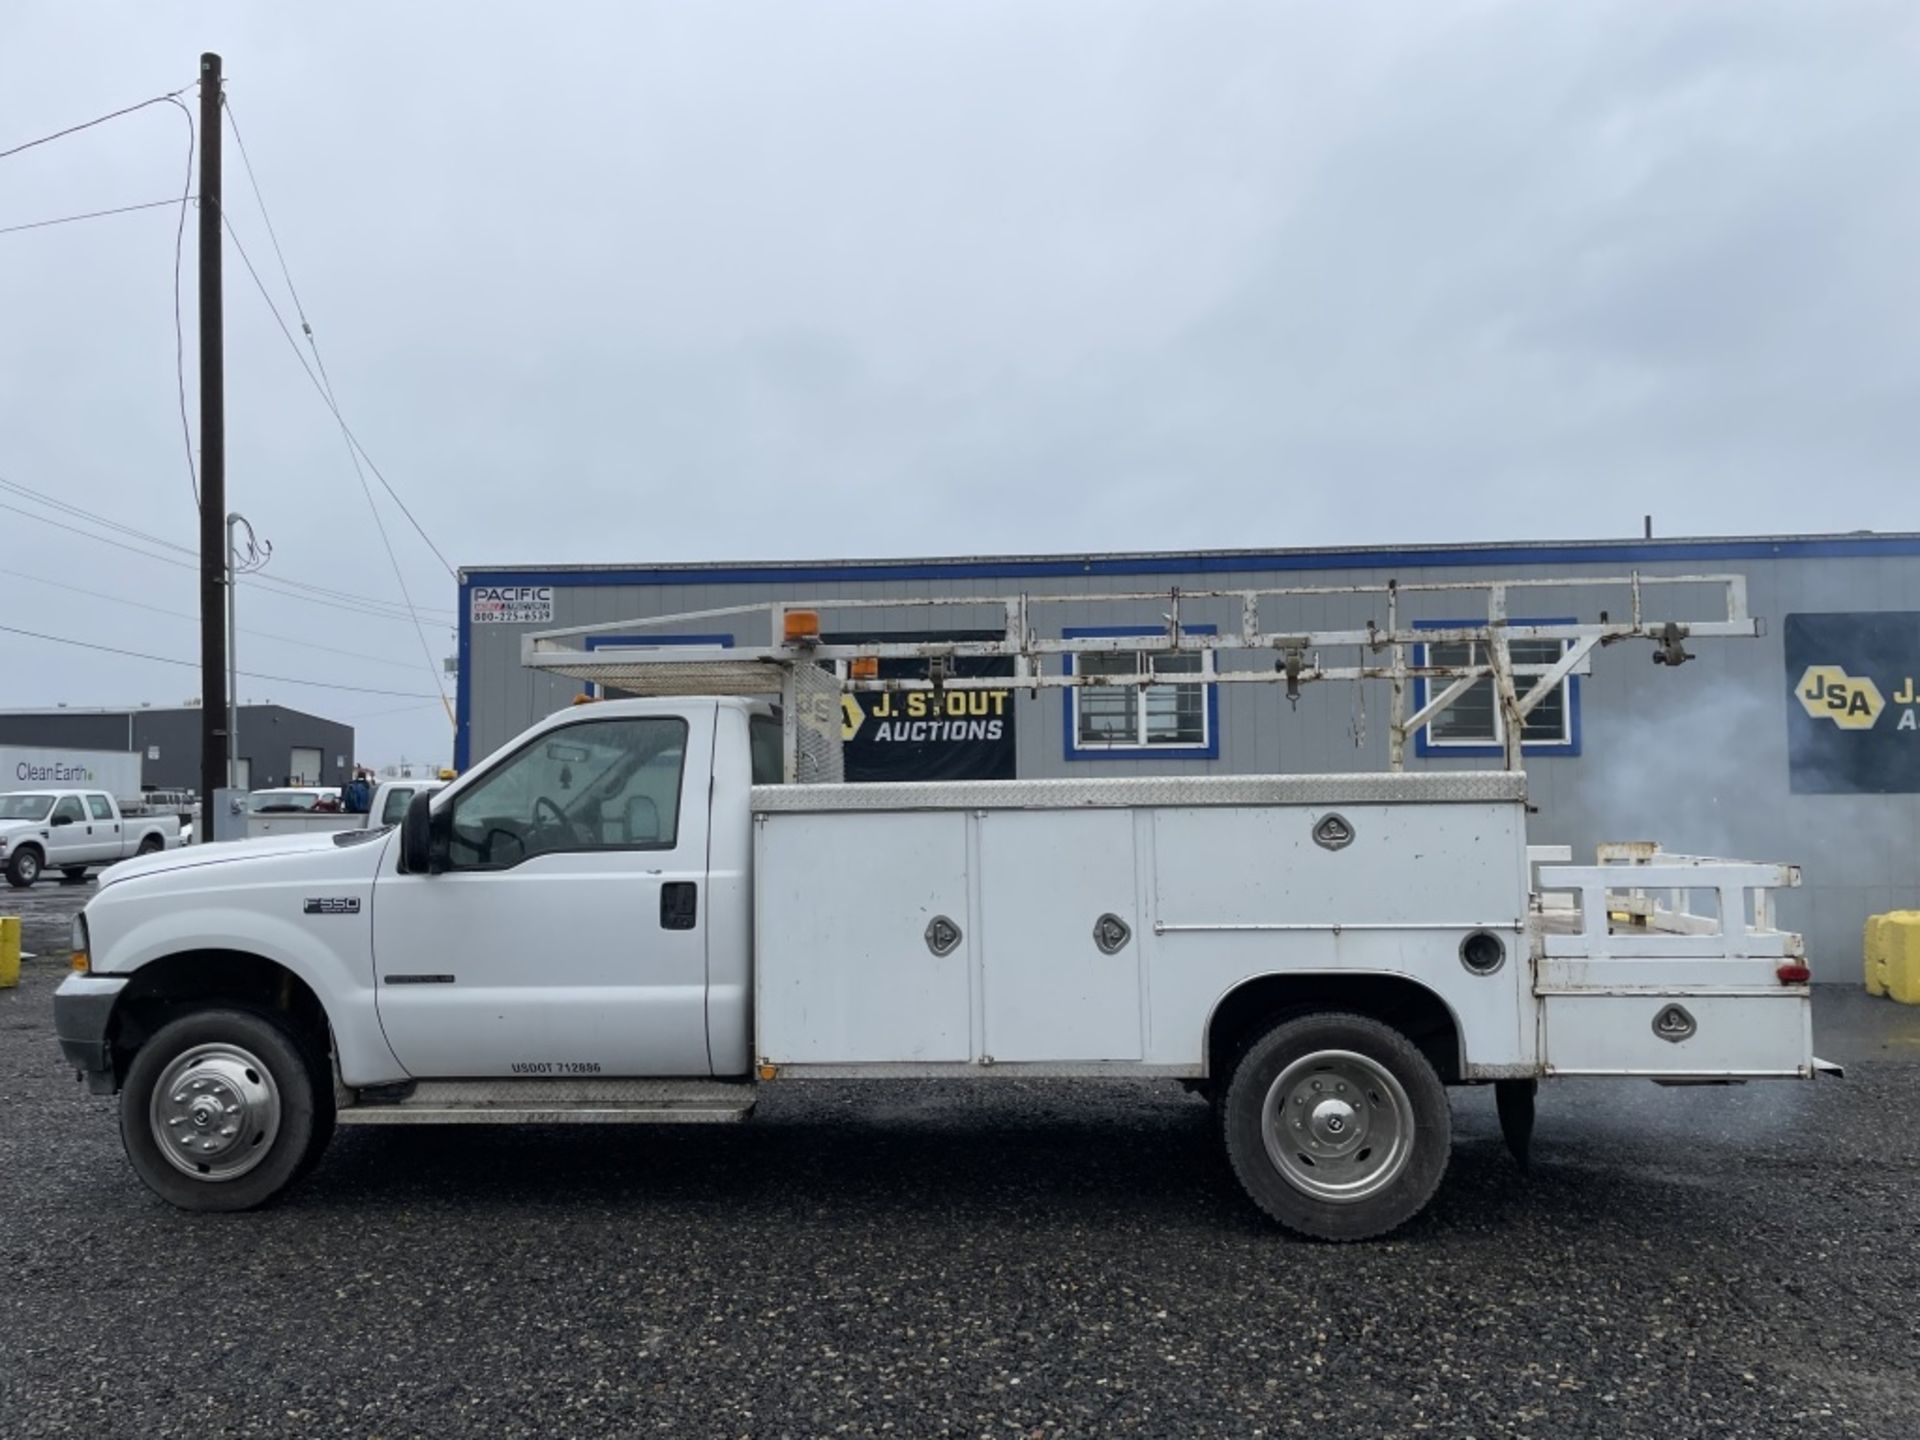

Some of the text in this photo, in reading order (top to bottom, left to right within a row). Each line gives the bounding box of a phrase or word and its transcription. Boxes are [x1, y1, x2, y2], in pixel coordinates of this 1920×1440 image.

[474, 588, 550, 601] PACIFIC
[873, 692, 899, 717] J.
[1805, 674, 1872, 716] JSA
[874, 720, 1004, 741] AUCTIONS
[511, 1062, 552, 1073] USDOT
